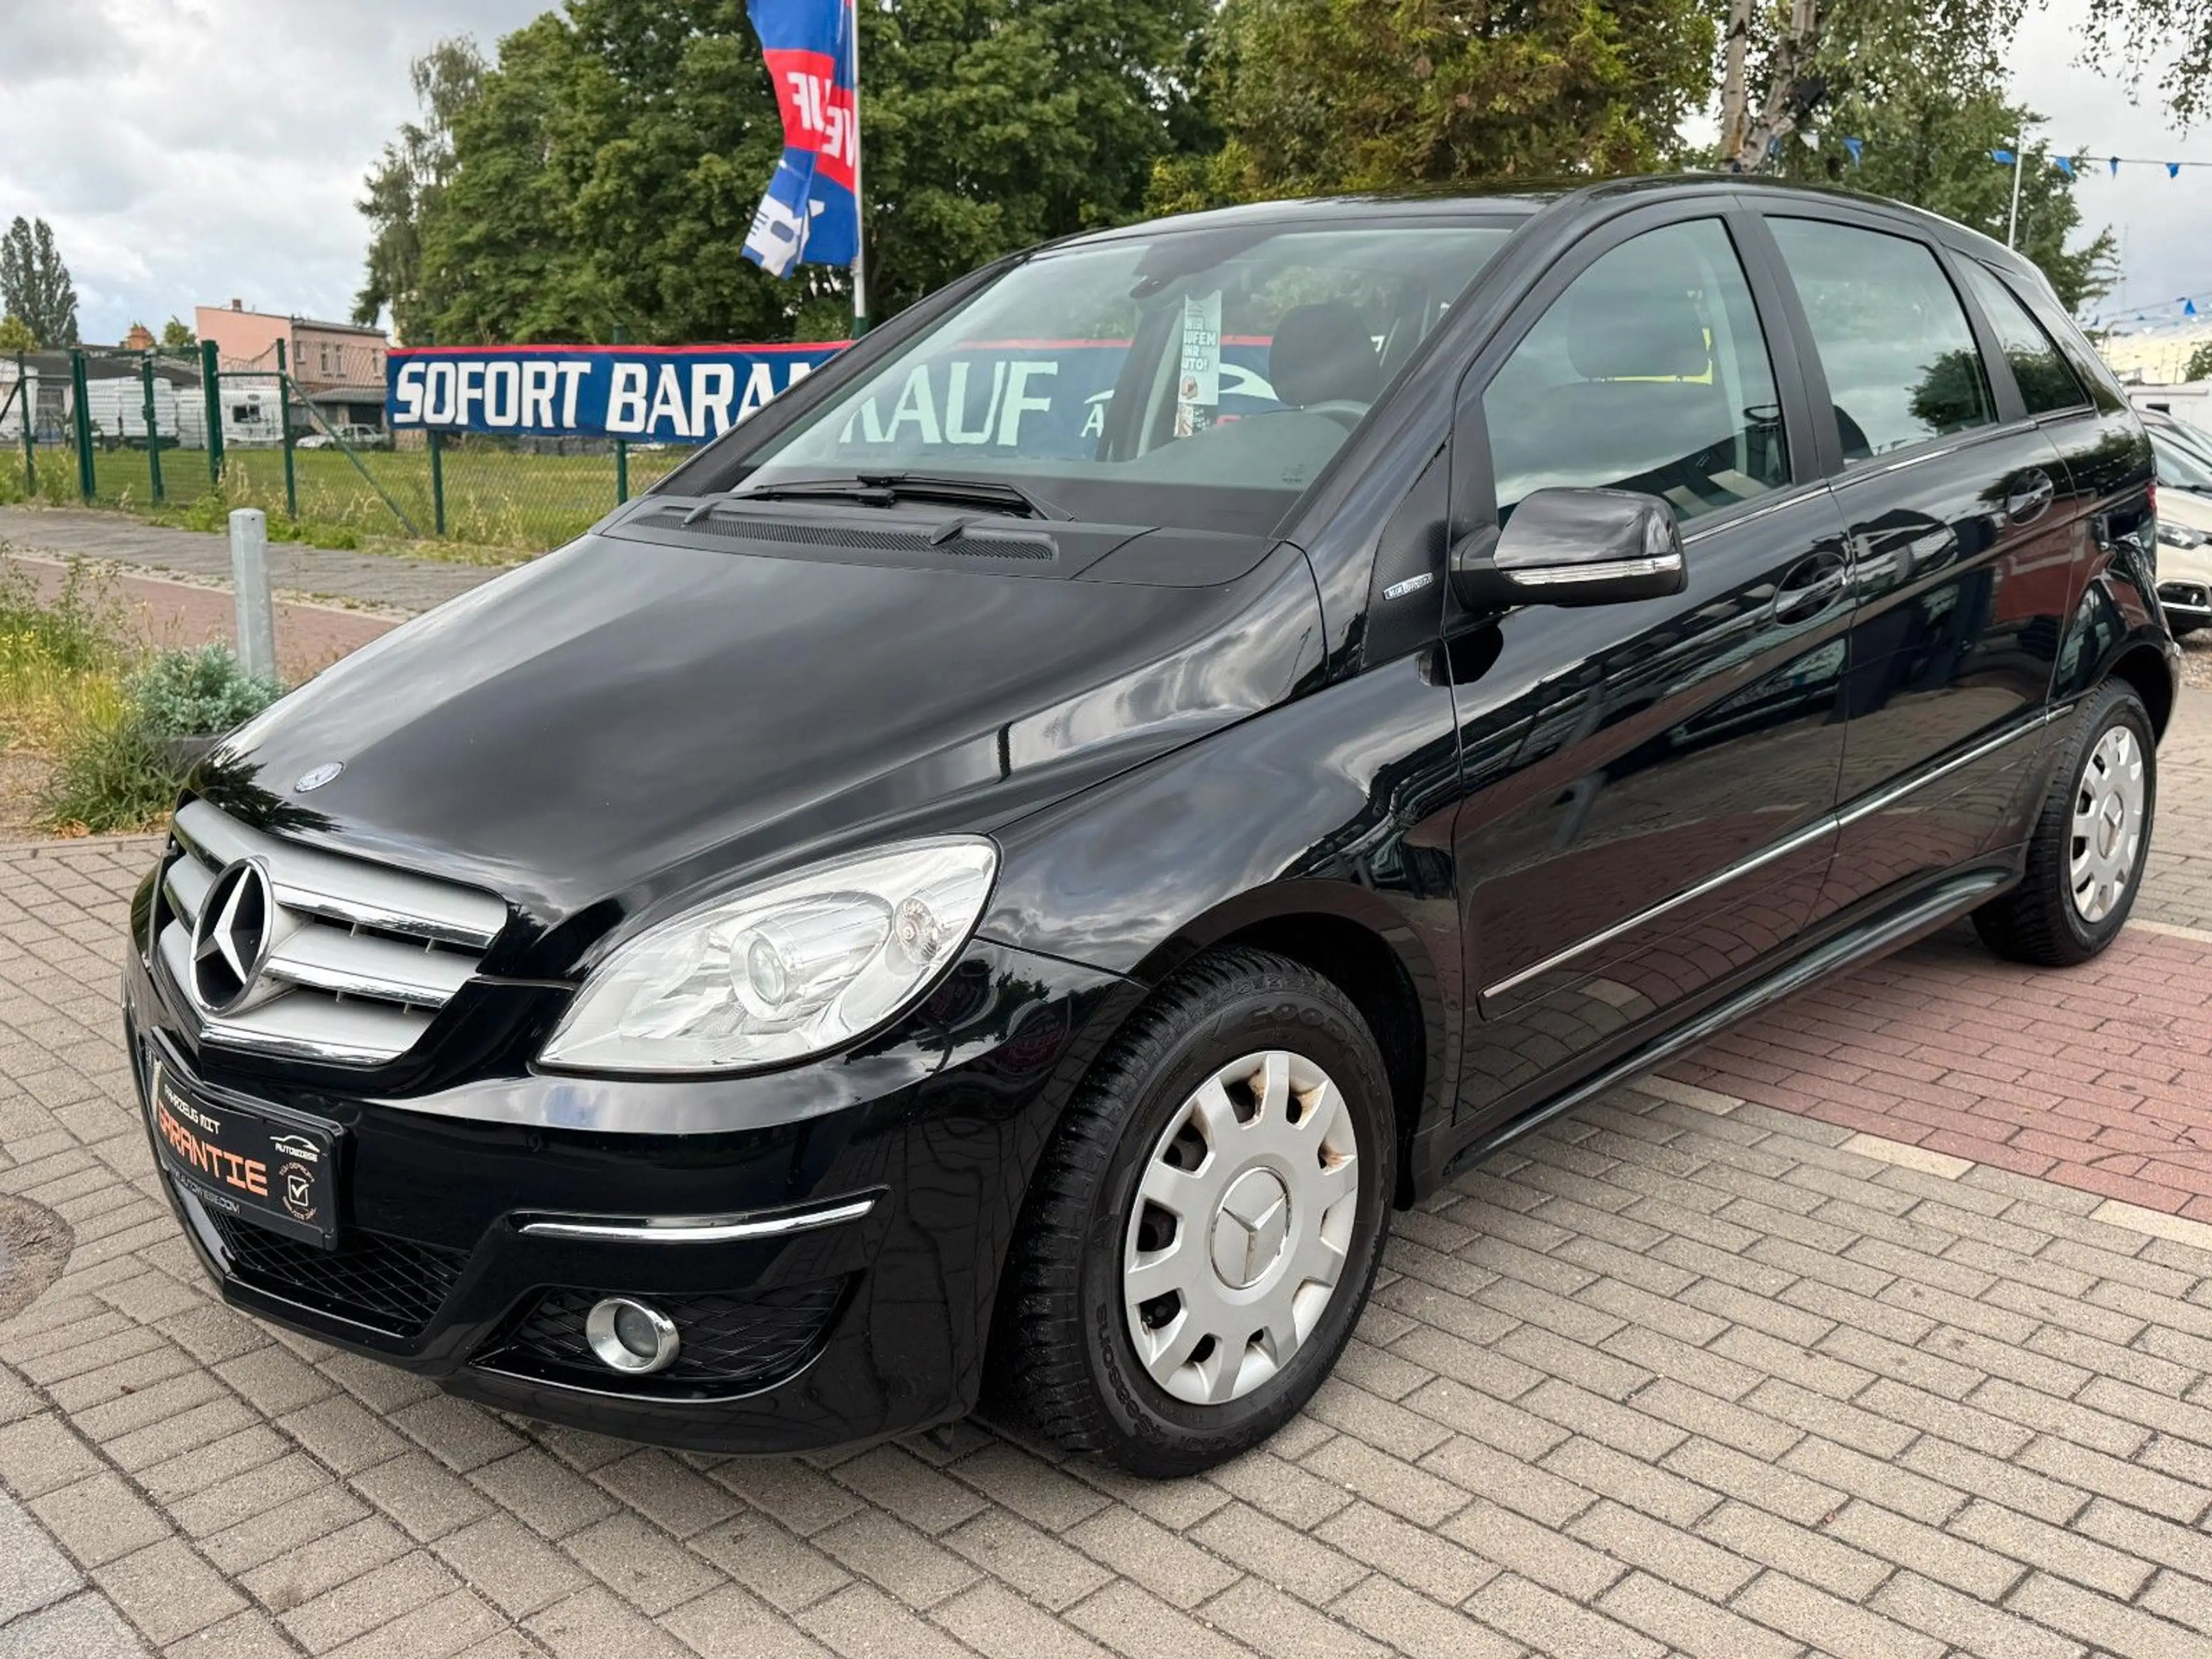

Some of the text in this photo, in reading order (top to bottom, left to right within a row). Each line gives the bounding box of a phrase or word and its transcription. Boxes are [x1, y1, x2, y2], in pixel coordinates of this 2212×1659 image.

[1183, 358, 1208, 371] UTO!
[393, 361, 592, 428] SOFORT
[200, 1113, 221, 1134] MIT
[158, 1099, 268, 1197] GARANTIE
